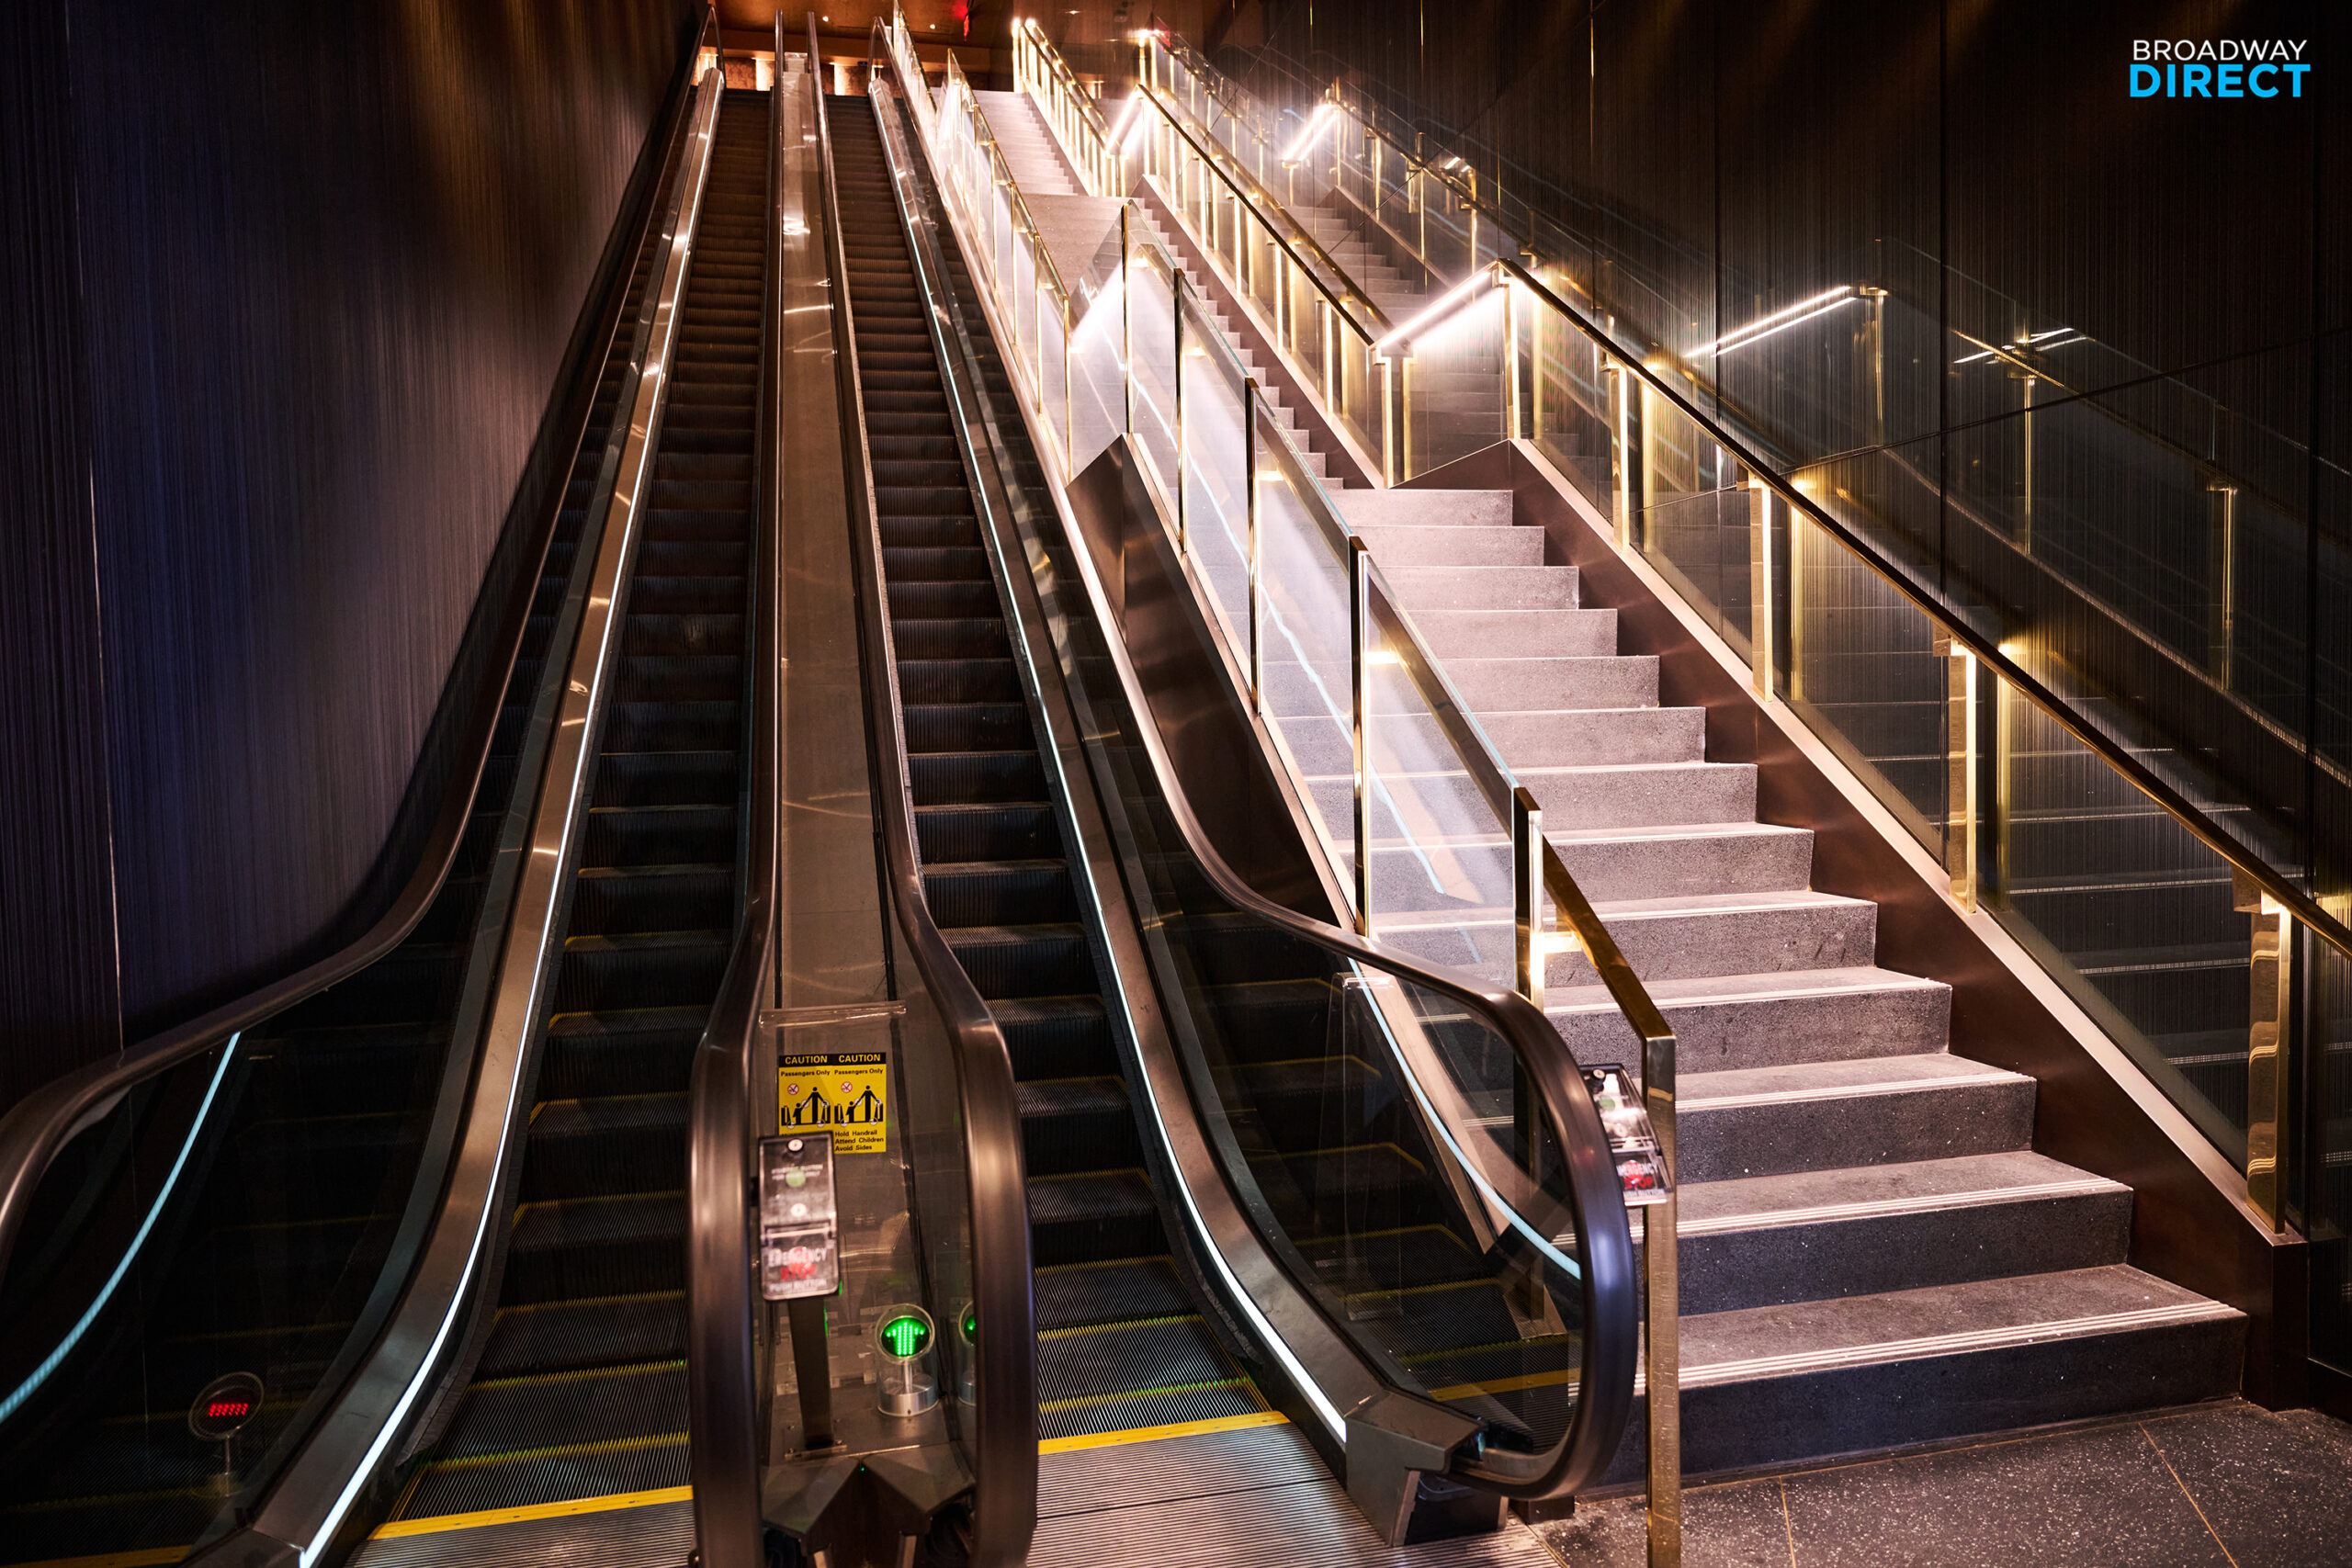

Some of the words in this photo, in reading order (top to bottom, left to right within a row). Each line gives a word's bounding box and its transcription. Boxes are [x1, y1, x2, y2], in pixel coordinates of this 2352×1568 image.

[785, 1055, 828, 1065] CAUTION
[838, 1054, 881, 1063] CAUTION
[780, 1263, 818, 1280] STOP
